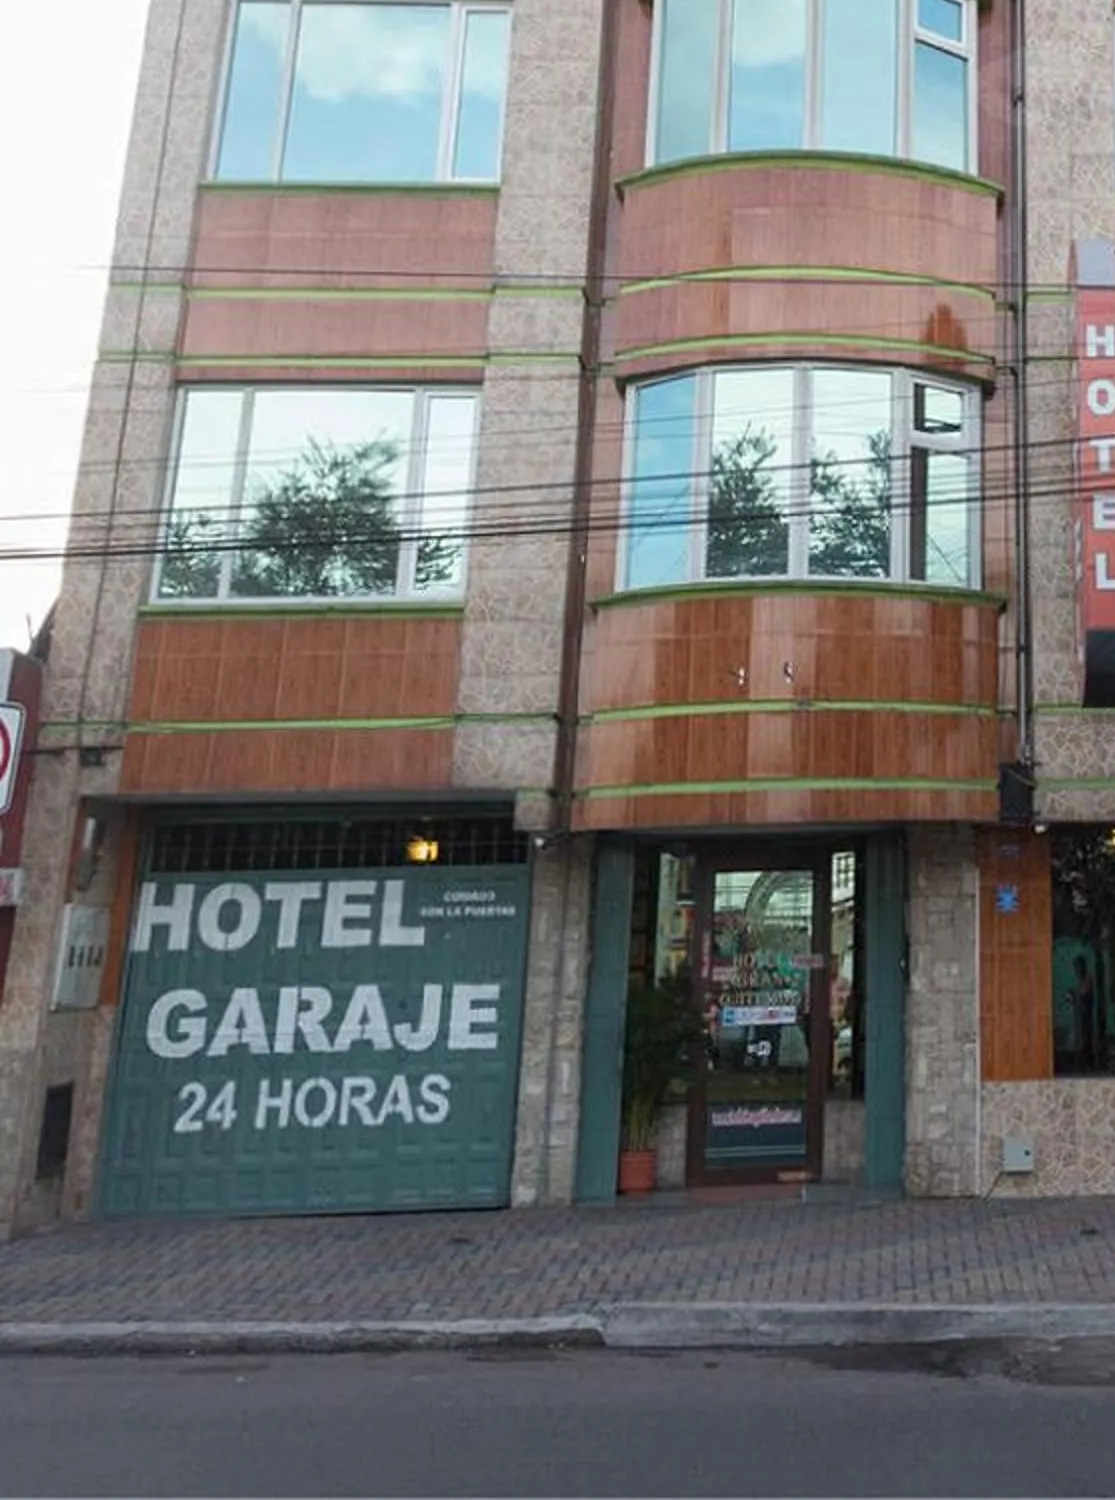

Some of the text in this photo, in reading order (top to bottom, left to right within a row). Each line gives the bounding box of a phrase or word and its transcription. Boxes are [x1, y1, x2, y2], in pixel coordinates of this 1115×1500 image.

[129, 879, 425, 952] HOTEL
[146, 983, 499, 1058] GARAJE
[173, 1074, 451, 1132] 24 HORAS
